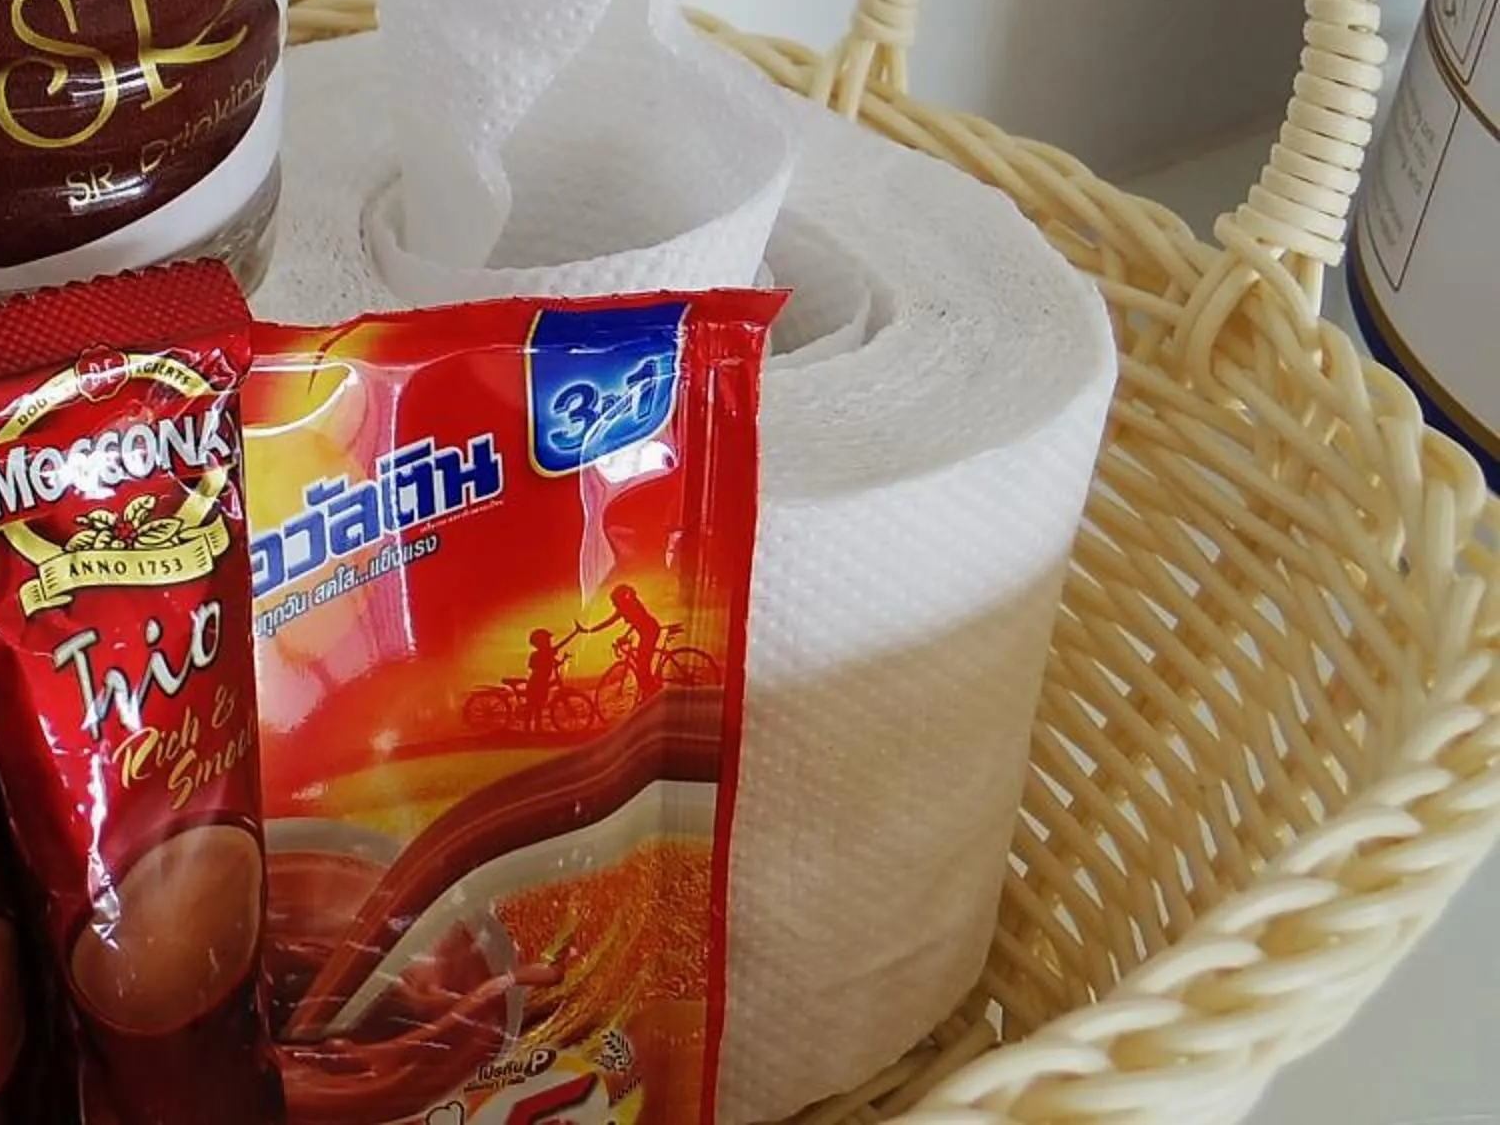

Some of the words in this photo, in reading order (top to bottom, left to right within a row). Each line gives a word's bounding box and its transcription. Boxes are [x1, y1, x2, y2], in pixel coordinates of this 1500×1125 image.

[65, 162, 116, 208] SR
[68, 560, 127, 578] ANNO
[138, 557, 184, 577] 1753
[250, 431, 504, 599] อวัลติน
[53, 598, 222, 742] Trio
[112, 705, 200, 790] Rich
[211, 684, 236, 730] &
